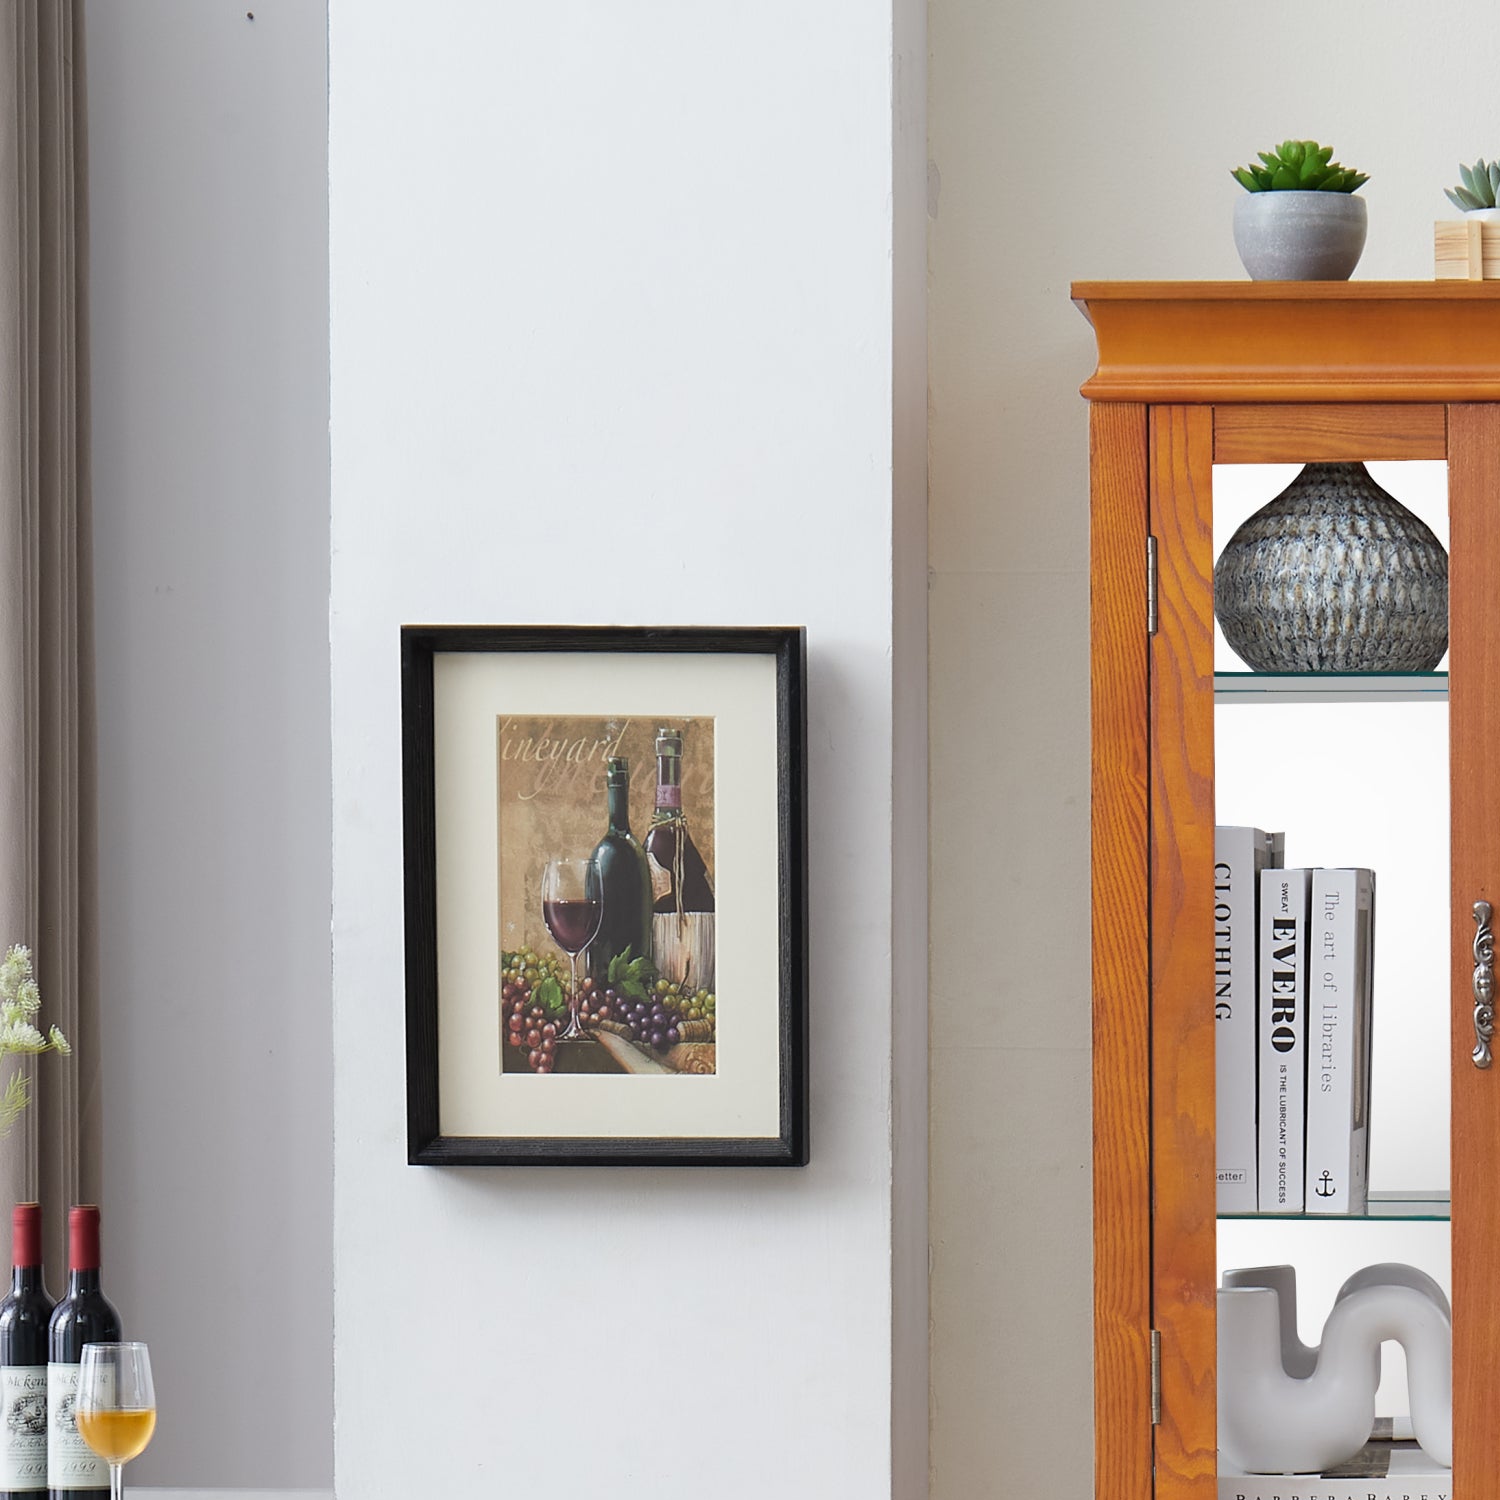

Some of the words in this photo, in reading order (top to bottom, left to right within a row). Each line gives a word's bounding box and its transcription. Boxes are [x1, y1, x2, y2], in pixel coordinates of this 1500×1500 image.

[1281, 882, 1289, 913] SWEAT
[1324, 891, 1339, 921] The
[1215, 862, 1232, 1020] CLOTHING
[1324, 931, 1336, 960] art
[1271, 916, 1297, 1053] EVERO
[1323, 972, 1337, 992] of
[1321, 1003, 1338, 1093] libraries
[1280, 1064, 1287, 1073] IS
[1279, 1076, 1287, 1093] THE
[1279, 1095, 1287, 1145] LUBRICANT
[1279, 1148, 1287, 1159] OF
[1216, 1173, 1243, 1181] etter
[1278, 1161, 1286, 1204] SUCCESS
